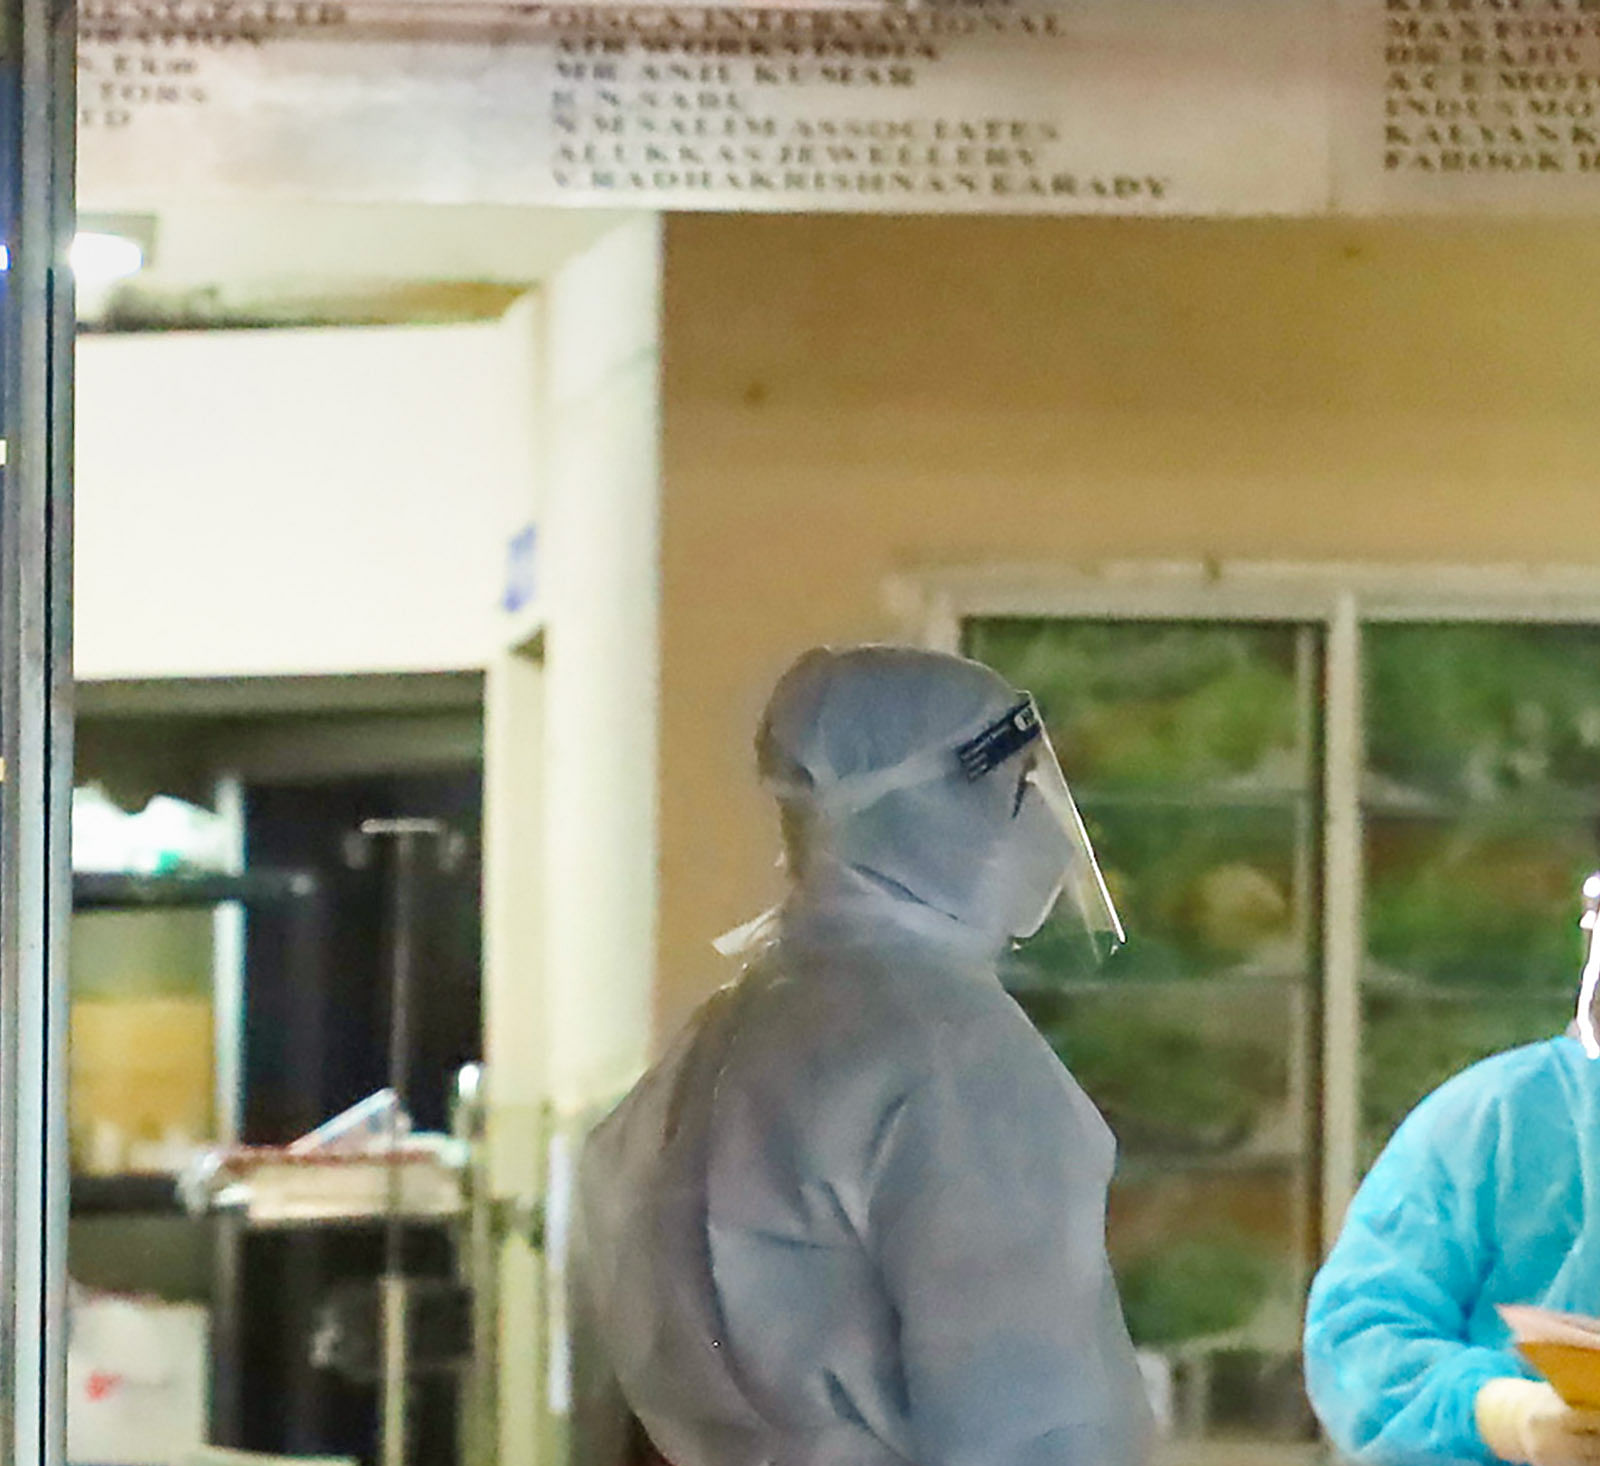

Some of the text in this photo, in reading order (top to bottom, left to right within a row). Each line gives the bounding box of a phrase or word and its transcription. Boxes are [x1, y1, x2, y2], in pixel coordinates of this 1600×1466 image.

[701, 11, 1062, 37] INTERNATIONAL
[554, 61, 915, 86] MR ANIL KUMAR
[797, 118, 1060, 141] ASSOCIATES
[777, 143, 1037, 167] JEWELLERY
[1383, 150, 1565, 173] FAROOK
[592, 171, 978, 194] RADHAKRISHNAN
